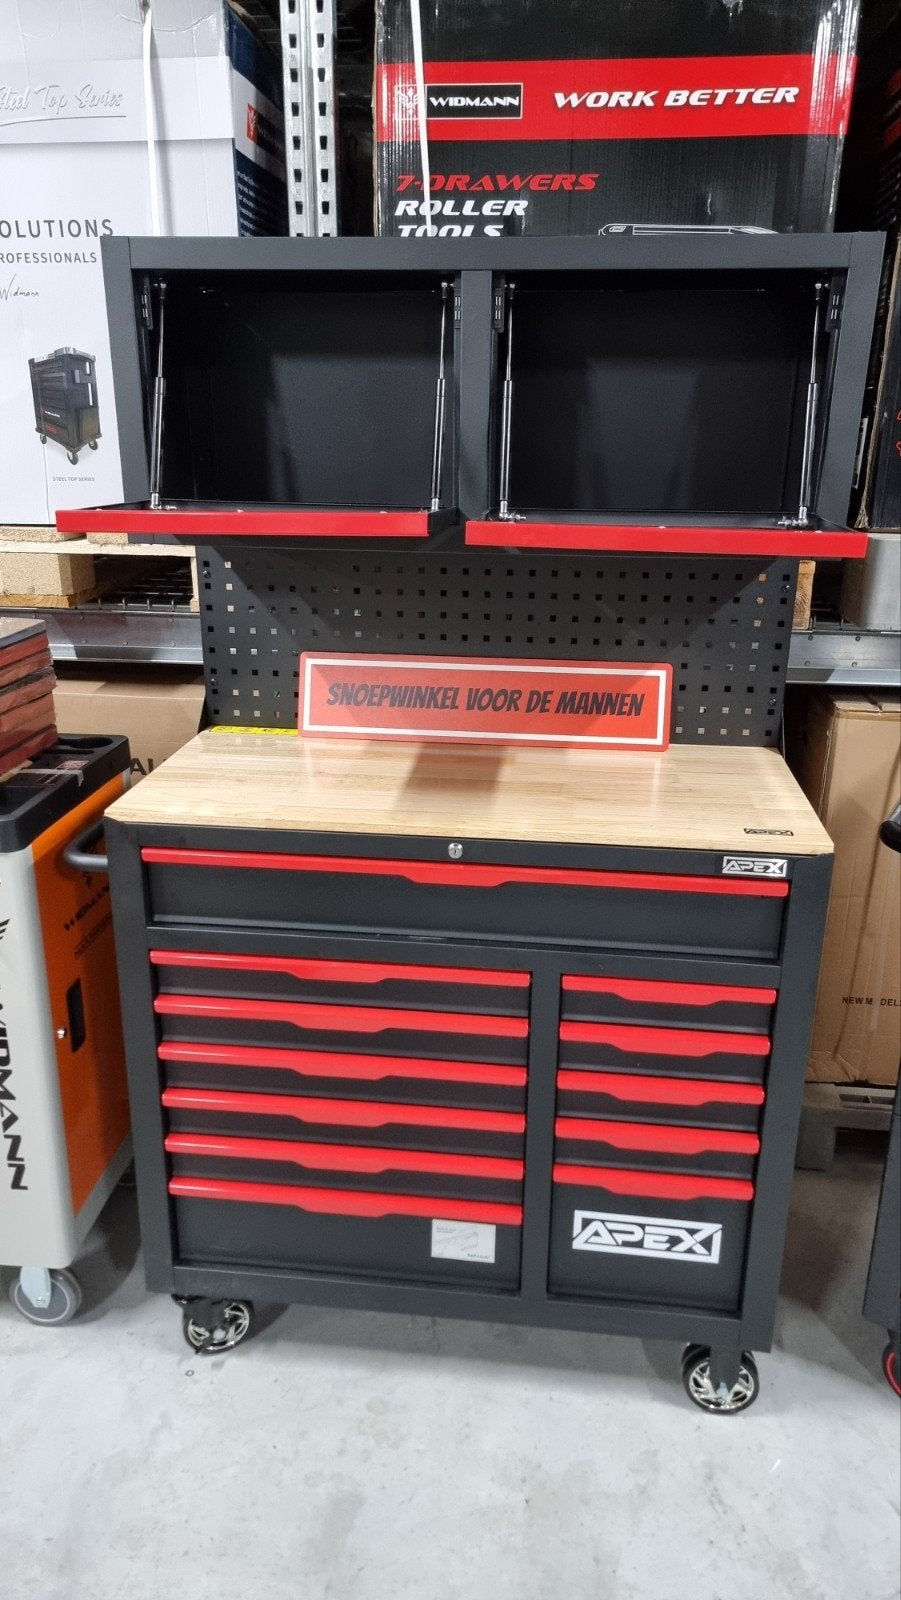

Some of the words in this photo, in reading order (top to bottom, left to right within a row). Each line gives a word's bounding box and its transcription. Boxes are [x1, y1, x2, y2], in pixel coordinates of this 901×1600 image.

[429, 96, 520, 107] WIDMANN
[553, 90, 659, 108] WORK
[663, 87, 800, 107] BETTER
[396, 173, 600, 192] 7-DRAWERS
[394, 199, 529, 216] ROLLER
[326, 682, 460, 711] SNOEPWINKEL
[466, 687, 523, 713] VOOR
[525, 689, 555, 714] DE
[554, 690, 646, 717] MANNEN
[722, 857, 787, 876] APEX
[842, 996, 864, 1005] NEW
[575, 1212, 719, 1261] APEX
